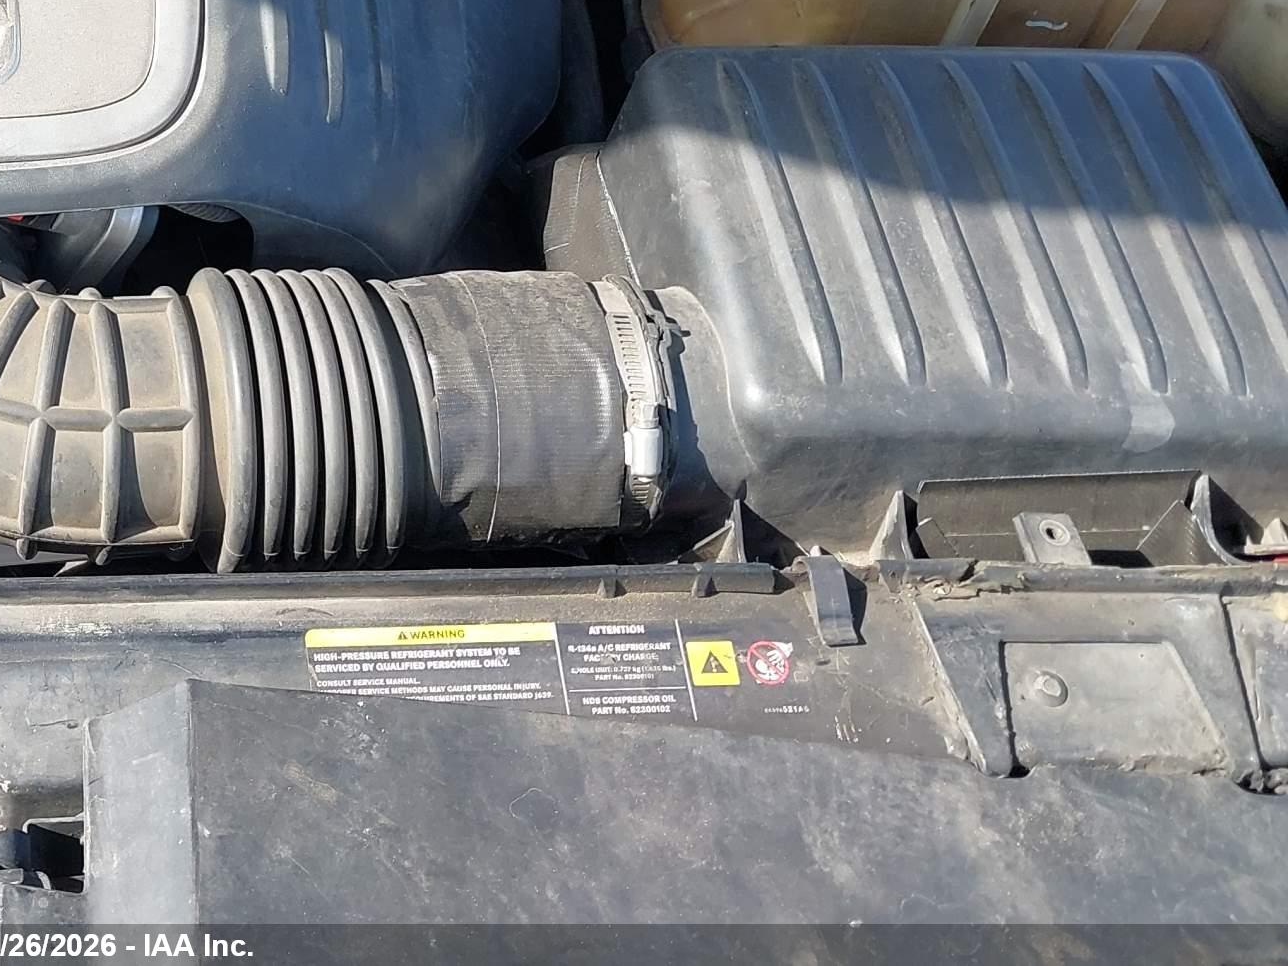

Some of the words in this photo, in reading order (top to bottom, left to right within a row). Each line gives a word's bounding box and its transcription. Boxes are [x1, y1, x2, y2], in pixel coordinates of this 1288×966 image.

[589, 624, 645, 635] ATTENTION
[410, 629, 465, 641] WARNING
[597, 643, 614, 652] A/C
[615, 642, 671, 651] REFRIGERANT
[314, 651, 389, 661] HIGH-PRESSURE
[391, 649, 454, 660] REFRIGERANT
[456, 647, 492, 657] SYSTEM
[493, 647, 506, 656] TO
[508, 646, 520, 655] BE
[584, 654, 621, 662] FACY
[314, 663, 360, 673] SERVICED
[362, 662, 374, 672] BY
[376, 661, 425, 671] QUALIFIED
[427, 659, 482, 669] PERSONNEL
[483, 658, 510, 667] ONLY.
[317, 679, 351, 687] CONSULT
[353, 678, 385, 686] SERVICE
[386, 677, 420, 685] MANUAL.
[391, 686, 427, 694] METHODS
[447, 684, 471, 692] CAUSE
[473, 683, 512, 691] PERSONAL
[514, 682, 541, 691] INJURY.
[478, 693, 492, 701] SAE
[493, 692, 533, 701] STANDARD
[602, 695, 660, 704] COMPRESSOR
[661, 694, 676, 703] OIL
[592, 707, 613, 715] PART
[614, 706, 629, 714] No.
